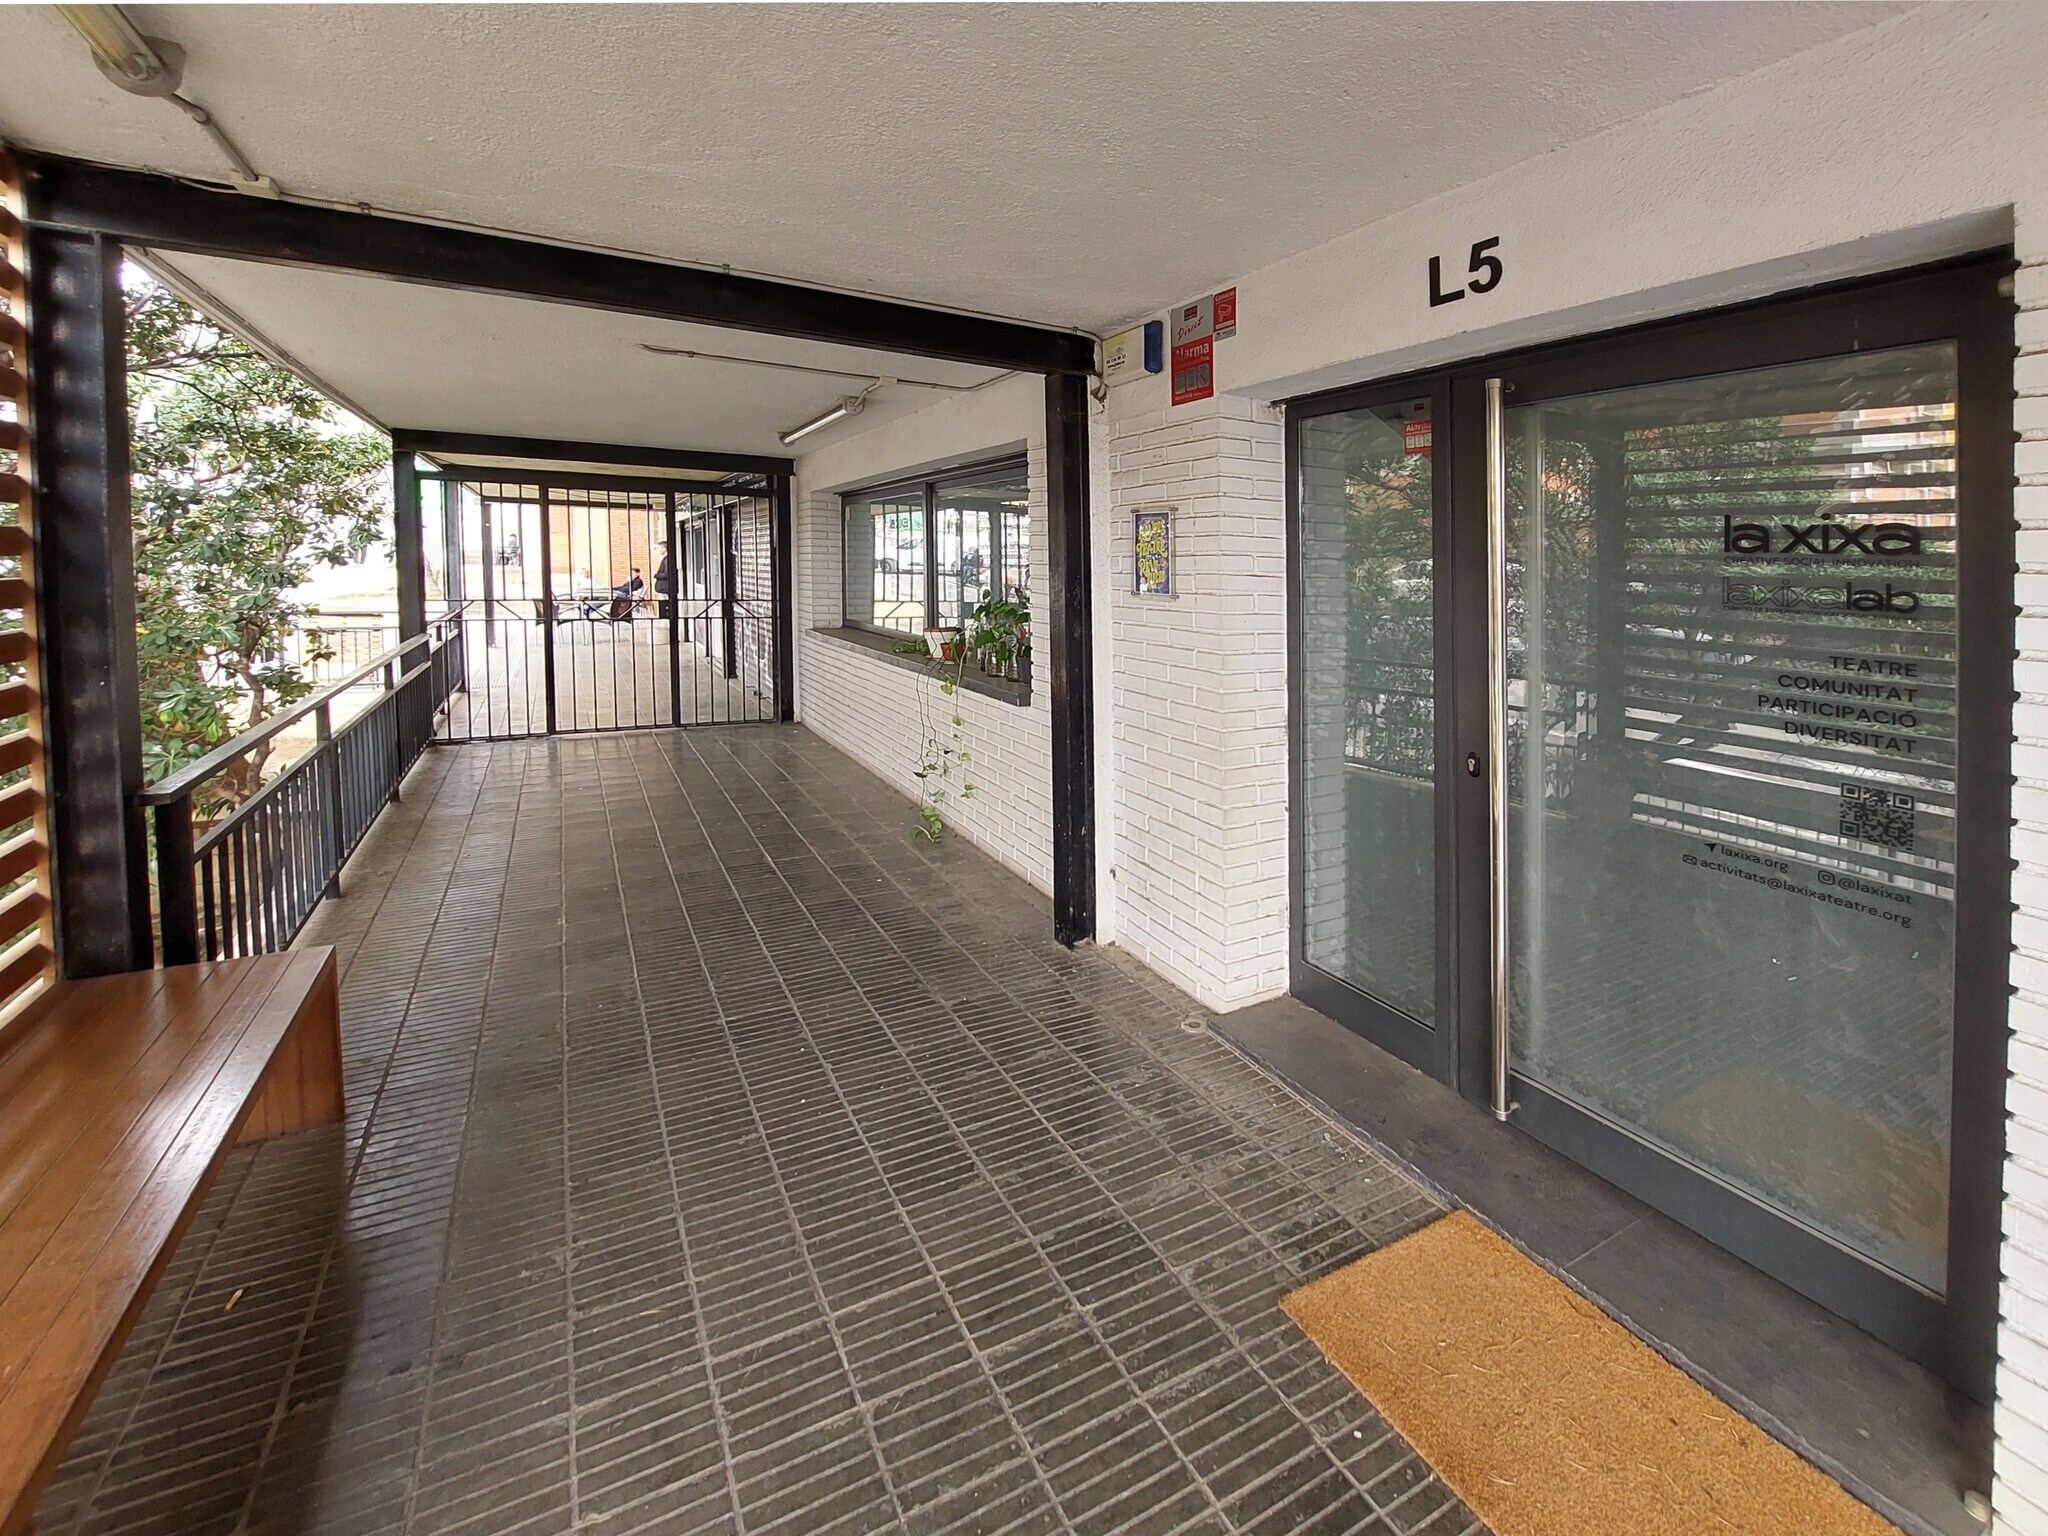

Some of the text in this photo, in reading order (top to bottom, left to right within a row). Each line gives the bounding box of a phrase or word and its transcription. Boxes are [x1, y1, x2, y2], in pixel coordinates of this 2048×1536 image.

[1429, 235, 1503, 307] L5
[1175, 343, 1210, 362] Alarma
[1780, 512, 1921, 556] xixa
[1723, 556, 1920, 568] CREATIVE SOCIAL INNOVATION
[1829, 655, 1918, 678] TEATRE
[1778, 674, 1918, 703] COMUNITAT
[1758, 694, 1917, 728] PARTICIPACIÓ
[1784, 721, 1917, 754] DIVERSITAT
[1721, 844, 1789, 874] laxixa.org
[1700, 859, 1913, 929] activitats@laxixateatre.org
[1838, 876, 1913, 906] @laxixat
